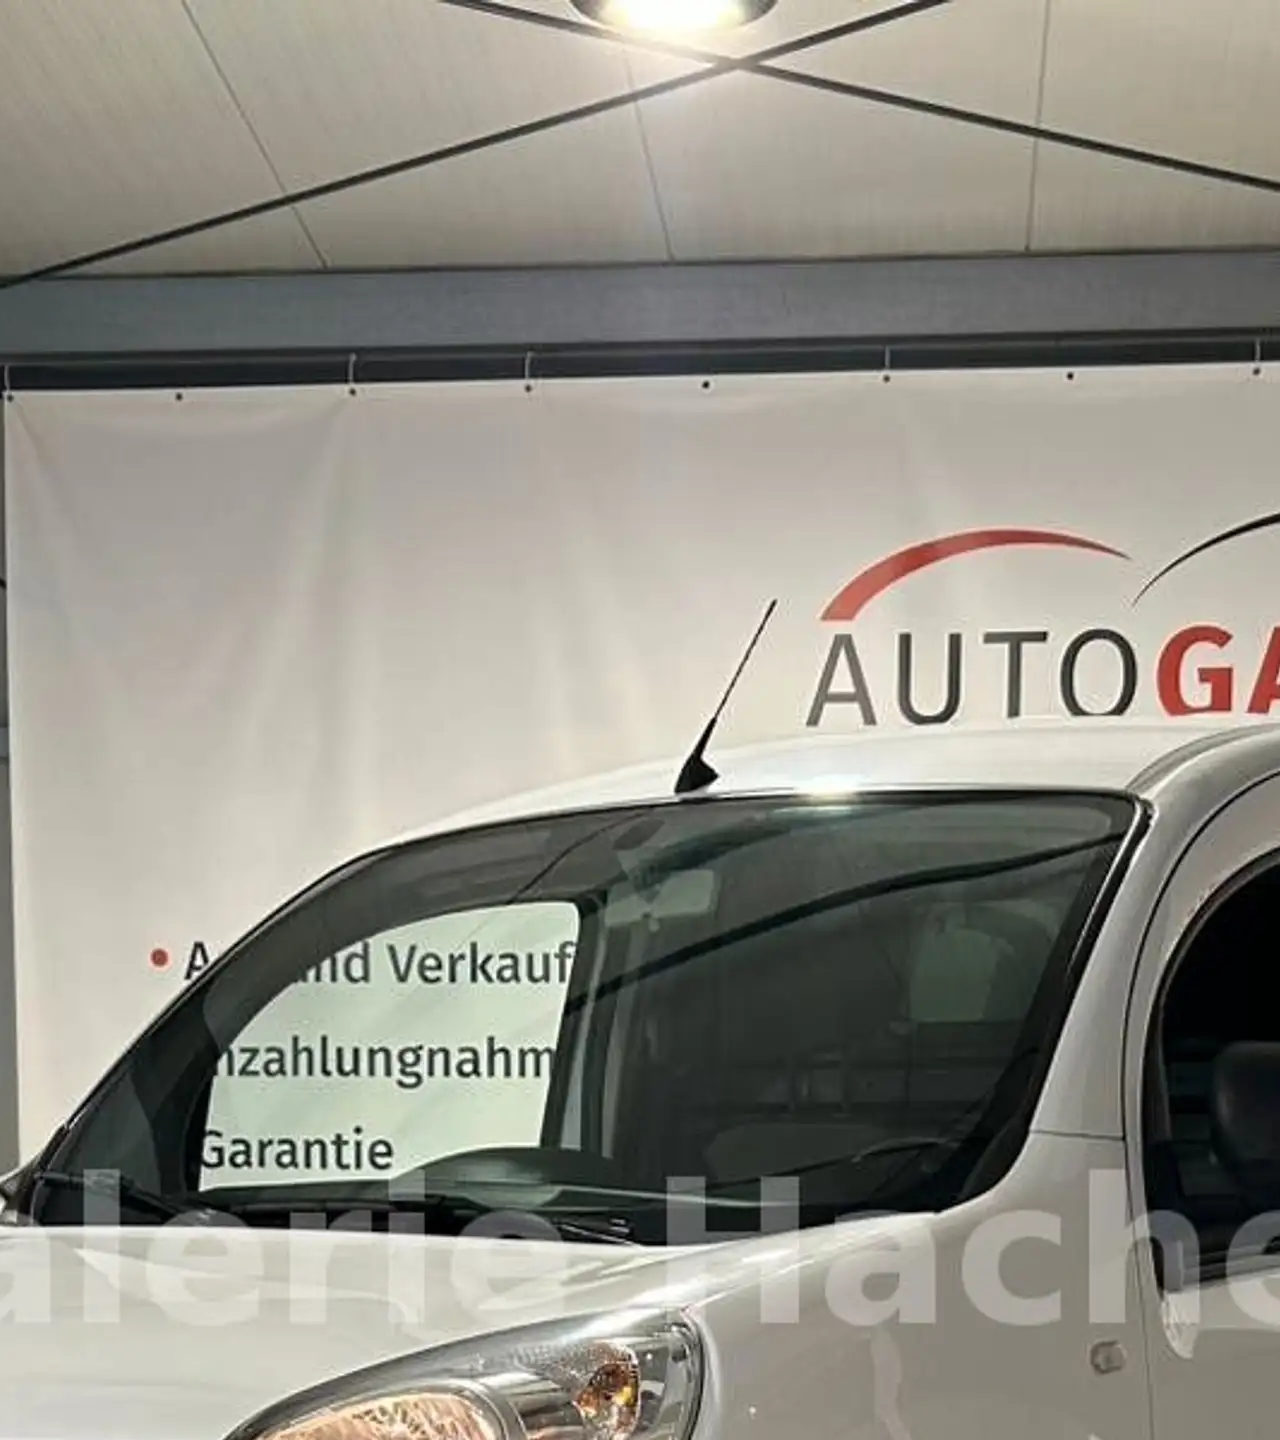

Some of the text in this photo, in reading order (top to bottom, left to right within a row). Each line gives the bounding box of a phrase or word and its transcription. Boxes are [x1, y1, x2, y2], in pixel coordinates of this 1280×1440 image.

[386, 941, 577, 985] Verkauf
[215, 1035, 555, 1090] nzahlungnahm
[201, 1127, 395, 1171] Garantie
